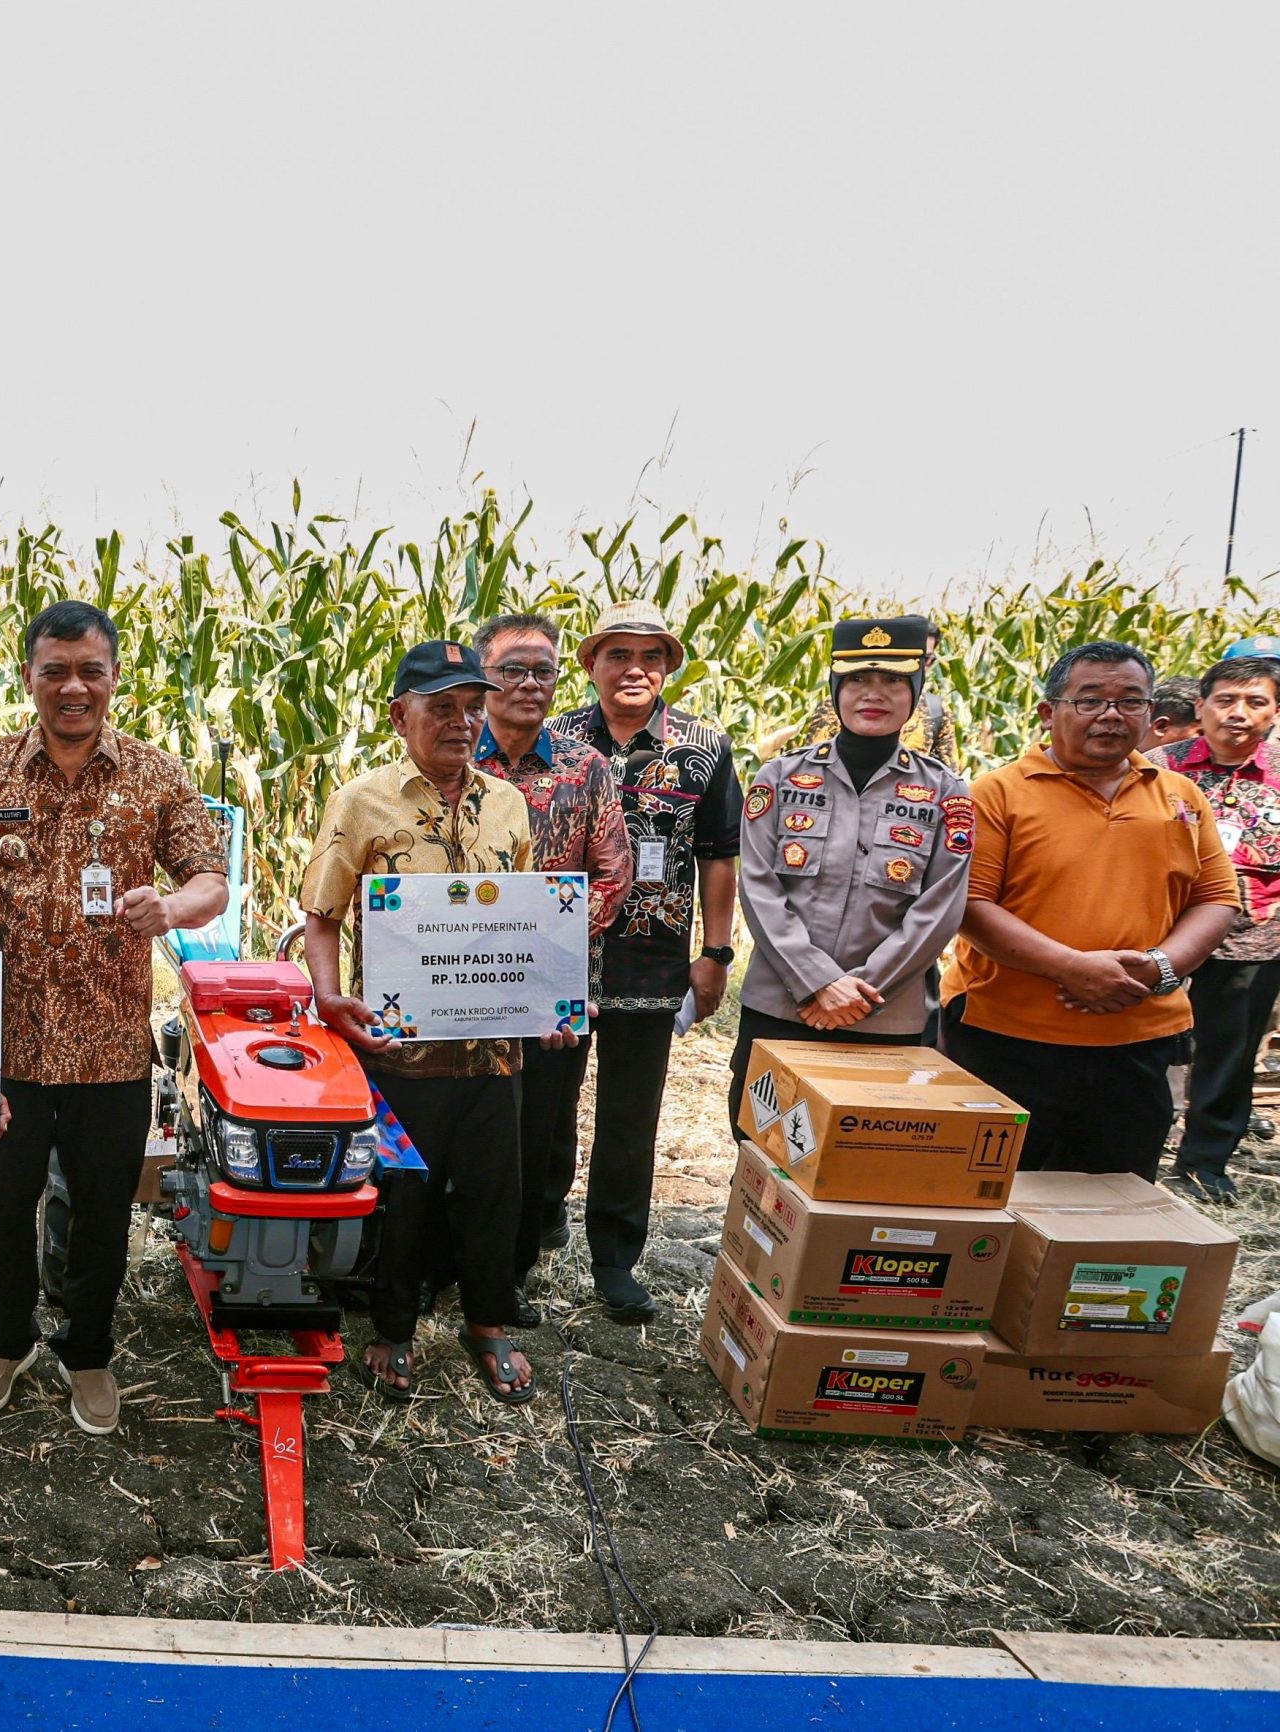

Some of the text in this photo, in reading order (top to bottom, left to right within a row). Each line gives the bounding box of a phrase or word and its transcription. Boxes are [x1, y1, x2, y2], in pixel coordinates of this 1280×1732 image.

[782, 789, 826, 806] TITIS
[885, 802, 934, 822] POLRI
[417, 922, 537, 933] BANTUAN PEMERINTAH
[421, 953, 534, 965] BENIH PADI 30 HA
[431, 972, 525, 985] RP. 12.000.000
[431, 1006, 529, 1017] POKTAN KRIDO UTOMO
[861, 1119, 936, 1133] RACUMIN
[283, 1153, 321, 1169] Shark
[851, 1255, 939, 1277] Kloper
[826, 1370, 914, 1393] Kloper
[274, 1427, 296, 1453] 62
